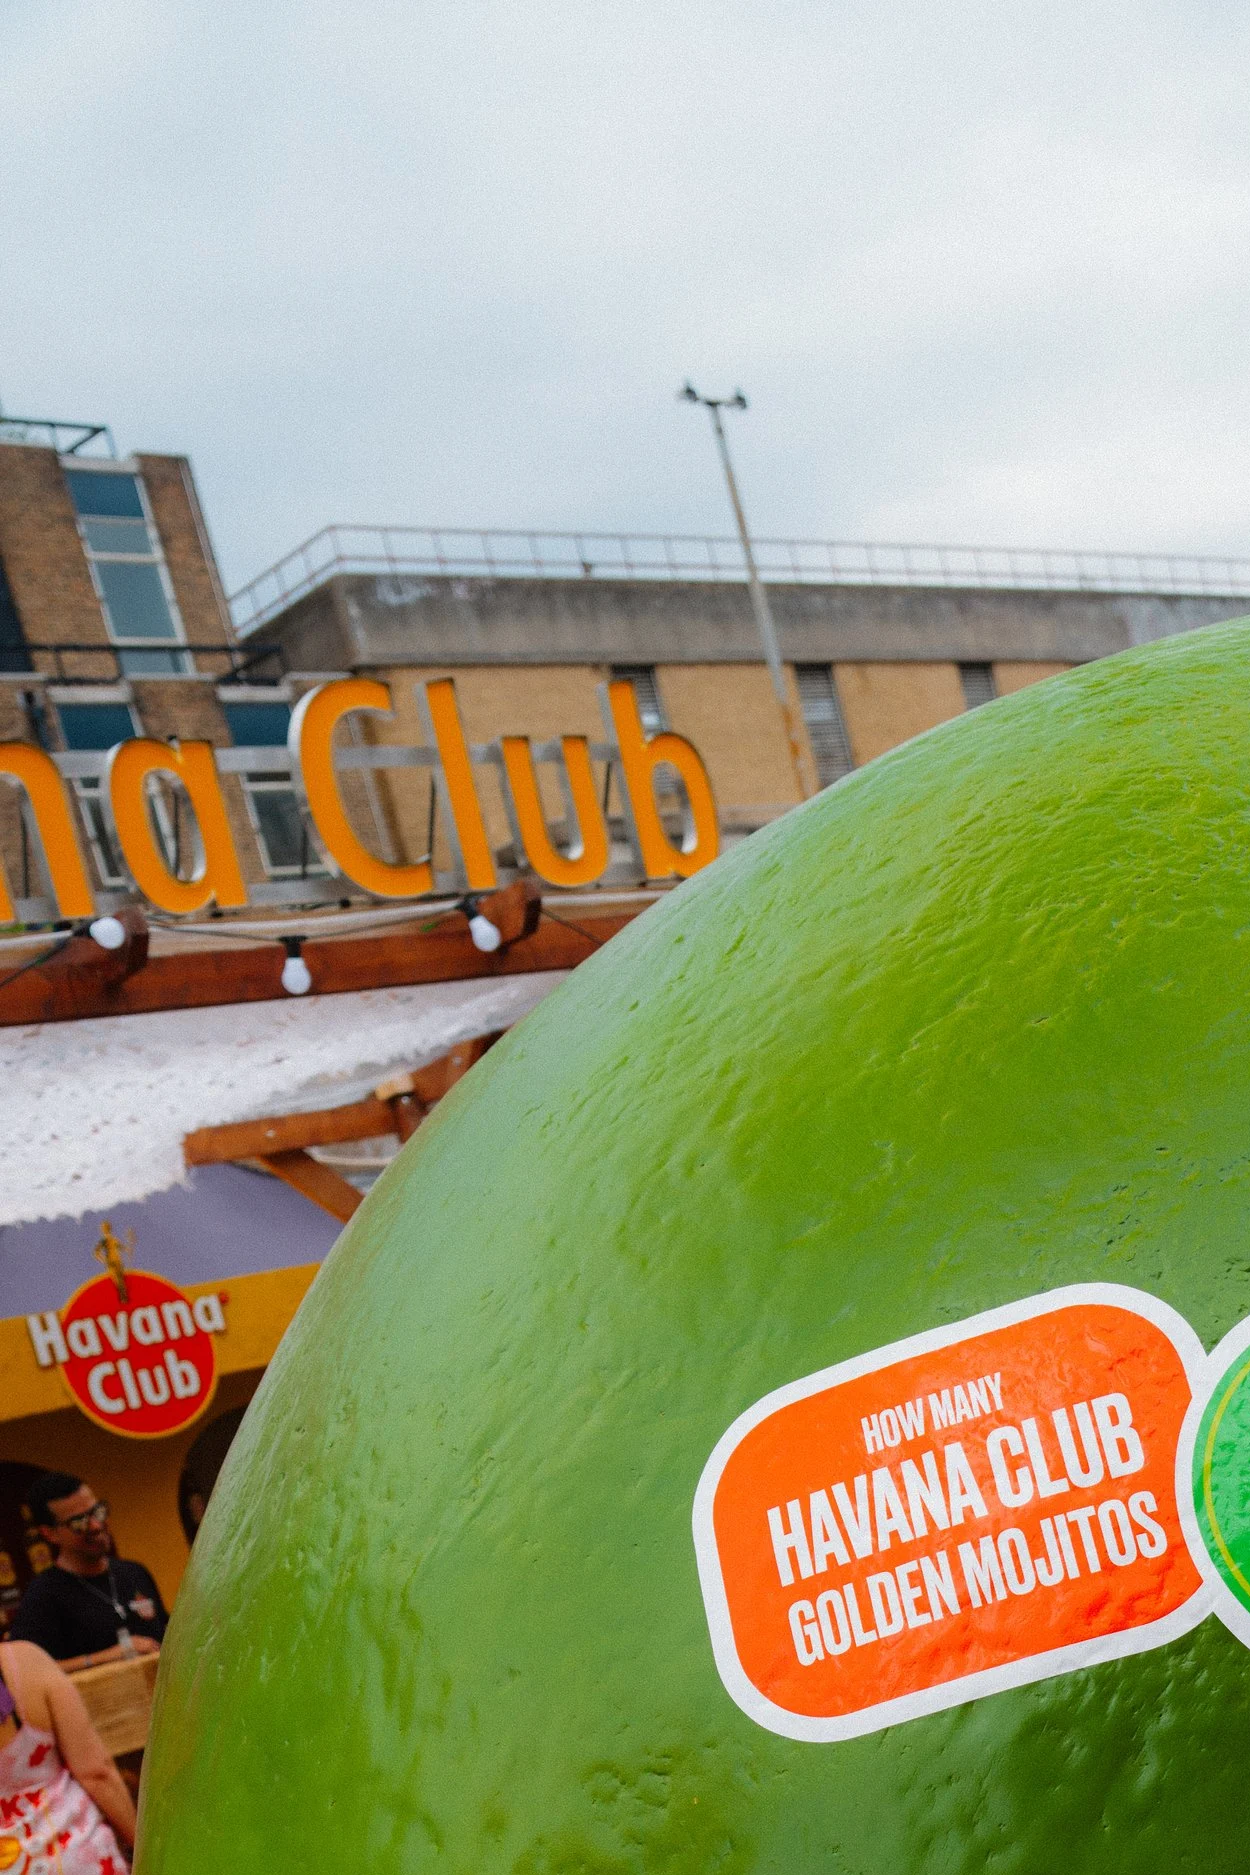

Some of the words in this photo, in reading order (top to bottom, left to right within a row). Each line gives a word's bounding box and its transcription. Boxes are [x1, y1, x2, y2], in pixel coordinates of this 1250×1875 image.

[293, 677, 720, 898] Club
[27, 1294, 226, 1367] Havana
[87, 1348, 201, 1414] Club
[861, 1398, 925, 1455] HOW
[928, 1372, 1005, 1431] MANY
[767, 1442, 989, 1587] HAVANA
[986, 1392, 1145, 1508] CLUB
[787, 1553, 962, 1667] GOLDEN
[958, 1490, 1168, 1609] MOJITOS
